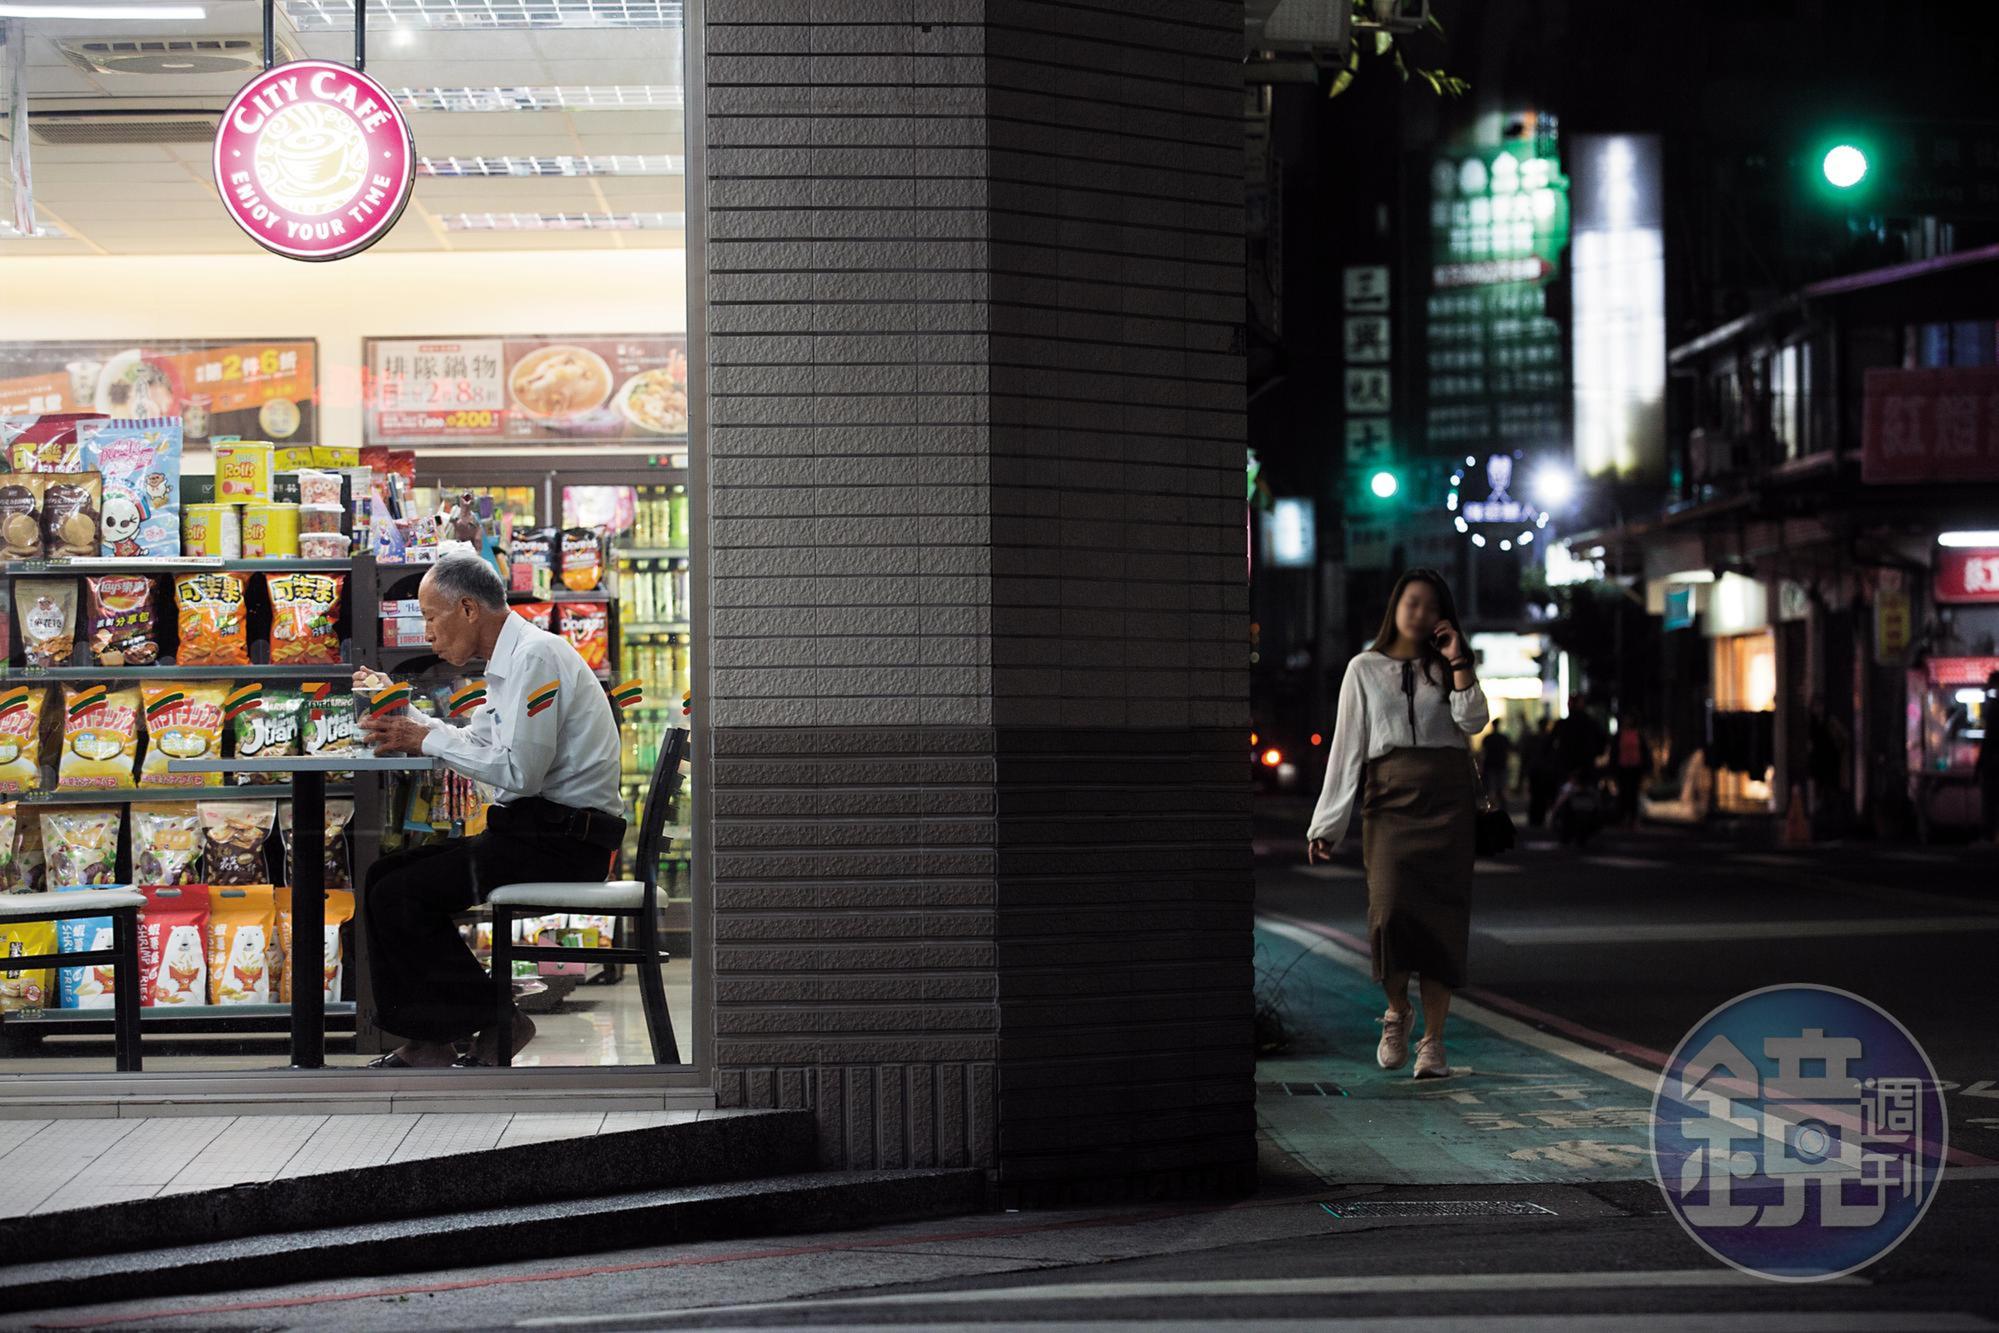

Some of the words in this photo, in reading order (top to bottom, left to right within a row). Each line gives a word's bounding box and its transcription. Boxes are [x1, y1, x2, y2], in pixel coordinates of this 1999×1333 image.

[233, 76, 298, 134] CITY
[310, 71, 393, 134] CAFÉ
[231, 171, 280, 229] ENJOY
[286, 218, 347, 241] YOUR
[348, 173, 392, 223] TIME
[224, 463, 256, 479] Rolls
[240, 718, 298, 755] Juan
[138, 924, 151, 965] SHRIMP
[64, 969, 73, 1003] FRIES
[140, 968, 149, 1001] FRIES
